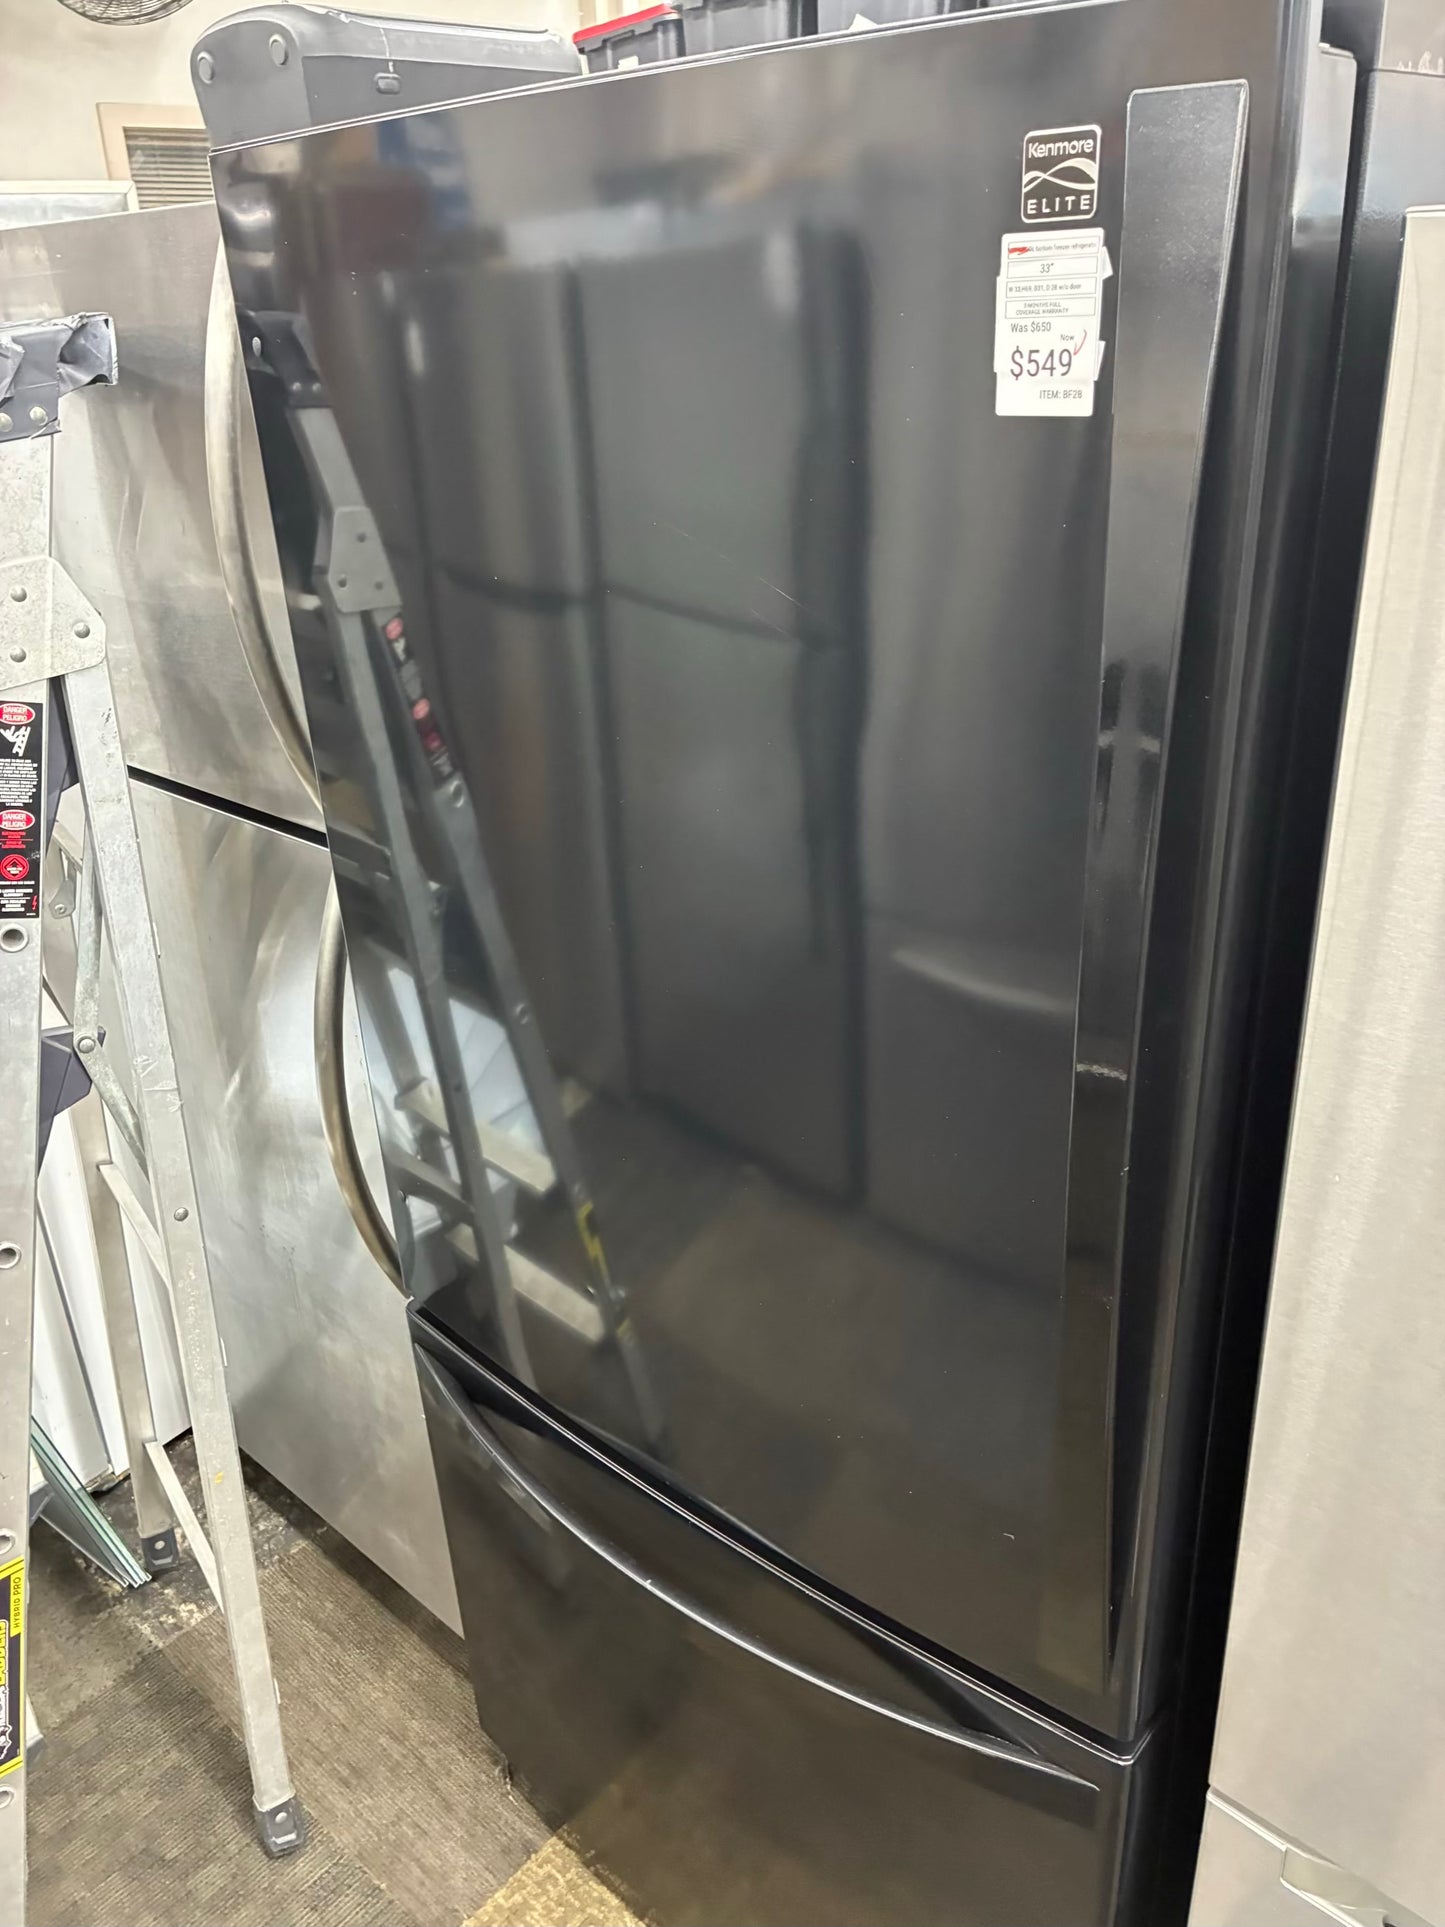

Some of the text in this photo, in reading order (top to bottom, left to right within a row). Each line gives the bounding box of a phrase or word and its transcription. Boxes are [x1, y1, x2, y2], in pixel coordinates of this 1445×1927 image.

[1028, 139, 1094, 158] Kenmore
[1027, 195, 1090, 214] ELITE
[1040, 262, 1054, 274] 33"
[1010, 321, 1051, 333] Was $650
[1010, 345, 1072, 381] $549
[1039, 389, 1061, 399] ITEM:
[3, 706, 27, 714] DANGER
[2, 714, 28, 722] PELIGRO
[2, 813, 26, 821] DANGER
[1, 820, 26, 828] PELIGRO
[13, 1576, 21, 1629] HYBRID PRO
